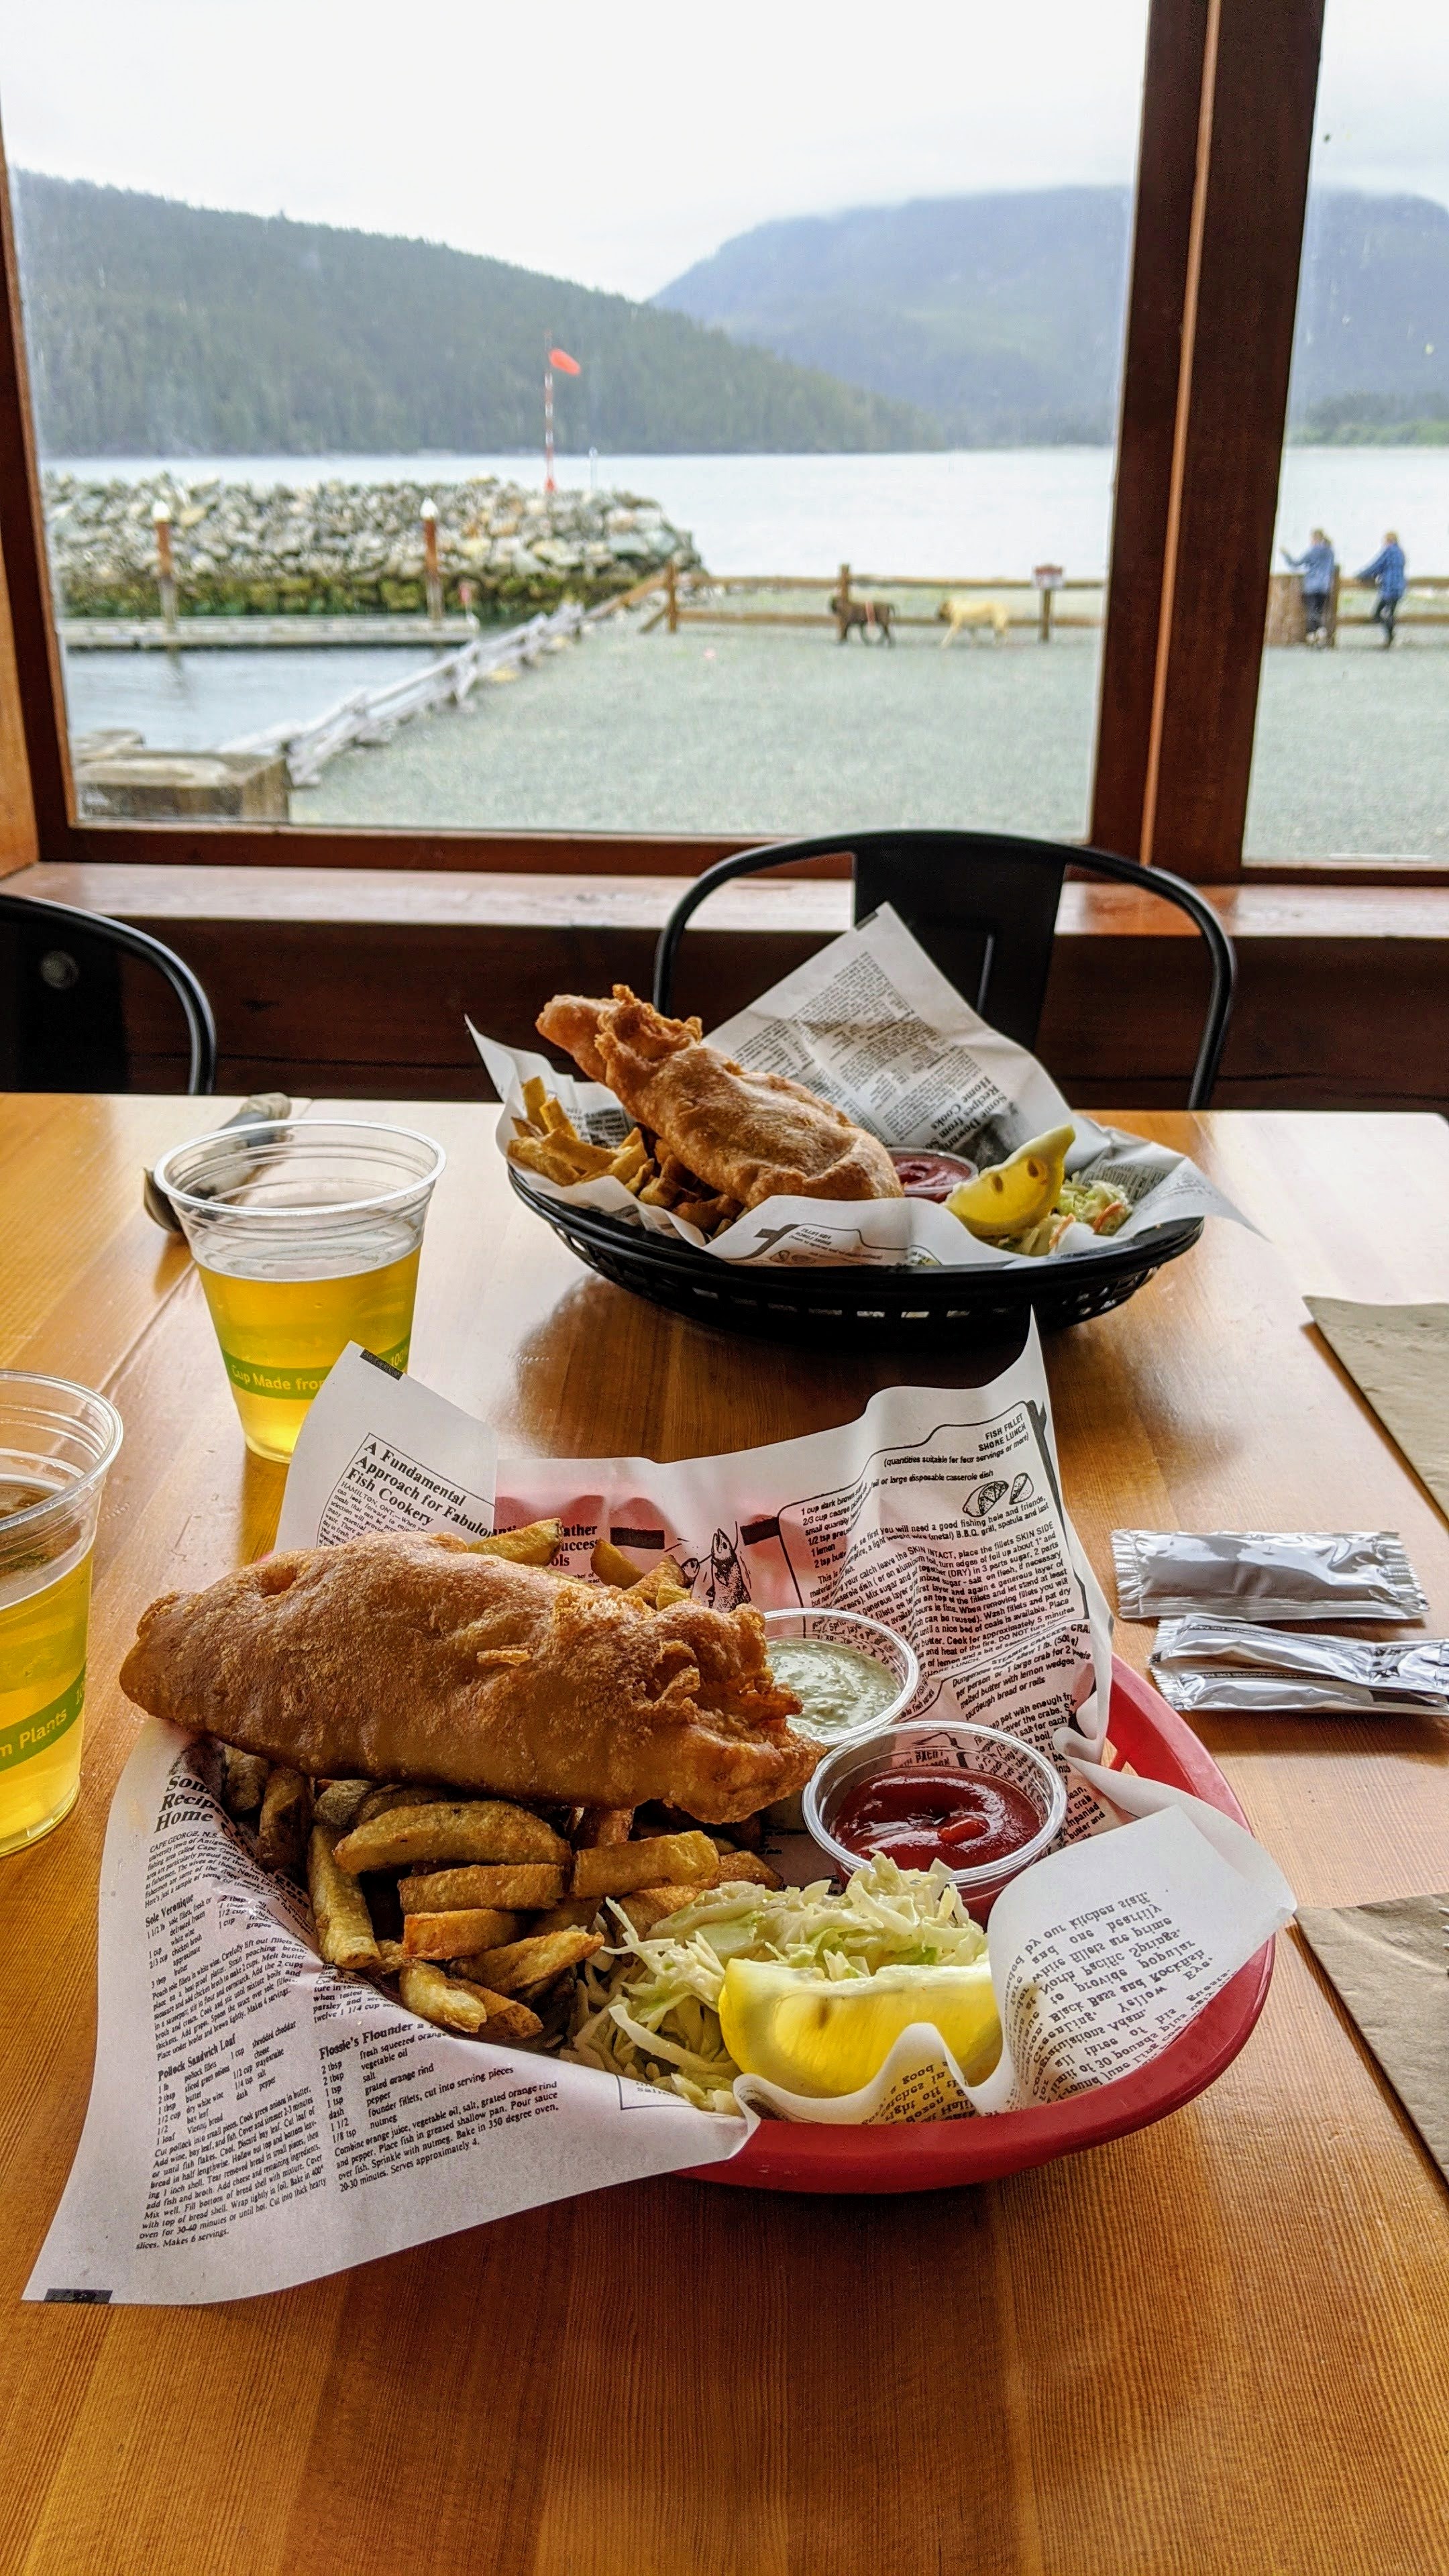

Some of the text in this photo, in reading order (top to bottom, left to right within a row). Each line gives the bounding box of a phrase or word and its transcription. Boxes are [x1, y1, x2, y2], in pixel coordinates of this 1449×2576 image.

[931, 1075, 991, 1129] Home Cooks
[939, 1084, 1000, 1138] Recipes from
[231, 1364, 250, 1385] Cup
[253, 1373, 290, 1390] Made
[979, 1423, 1026, 1452] SHORE LUNCH
[985, 1413, 1023, 1440] FISH FILLET
[883, 1449, 1004, 1467] (quantities suitable servings
[355, 1456, 420, 1500] Approach
[421, 1495, 443, 1512] for
[364, 1442, 466, 1507] A Fundamental
[890, 1469, 994, 1485] large disposable casserole dish
[341, 1481, 378, 1507] HAMILTON,
[346, 1467, 434, 1525] Fish Cookery
[328, 1507, 365, 1531] many essential
[331, 1501, 352, 1517] selection
[350, 1495, 386, 1519] look forward
[351, 1504, 362, 1513] that
[912, 1497, 1046, 1532] need good fishing and friends,
[561, 1524, 598, 1538] ather
[928, 1510, 1037, 1541] (metal) spatula and
[561, 1539, 601, 1551] uccess
[908, 1521, 1054, 1559] SKIN INTACT, place fillets SKIN SIDE
[1013, 1532, 1056, 1553] about and
[1026, 1550, 1061, 1568] necessary
[948, 1568, 971, 1578] (DRY)
[983, 1595, 1016, 1610] removing
[983, 1607, 1005, 1620] Wash
[1049, 1598, 1069, 1609] Place
[983, 1619, 1035, 1640] approximately
[1034, 1652, 1050, 1663] crab
[981, 1658, 1075, 1695] butter with lemon wedges
[19, 1709, 67, 1750] Plants
[166, 1775, 211, 1794] Som
[154, 1811, 214, 1833] Home
[146, 1894, 193, 1927] Sole Veronique
[262, 1953, 278, 1962] Melt
[319, 2023, 414, 2060] Flossie's Flounder
[360, 2035, 415, 2059] fresh squeezed
[158, 2033, 235, 2082] Pollock Sandwich Loaf
[361, 2053, 395, 2070] vegetable
[363, 2072, 376, 2083] salt
[365, 2062, 435, 2096] grated orange rind
[329, 2067, 514, 2120] dash founder fillets, into serving pieces
[335, 2081, 557, 2157] Combine orange vegetable grated orange rind
[370, 2114, 398, 2129] nutmeg
[379, 2092, 558, 2153] Place shallow pan. Pour sauce
[372, 2104, 559, 2168] Sprinkle with Bake 350 degree oven.
[339, 2141, 470, 2192] 20-30 minutes. Serves approximately
[177, 2218, 227, 2234] 30-40 minutes
[136, 2228, 229, 2249] slices. Makes servings.
